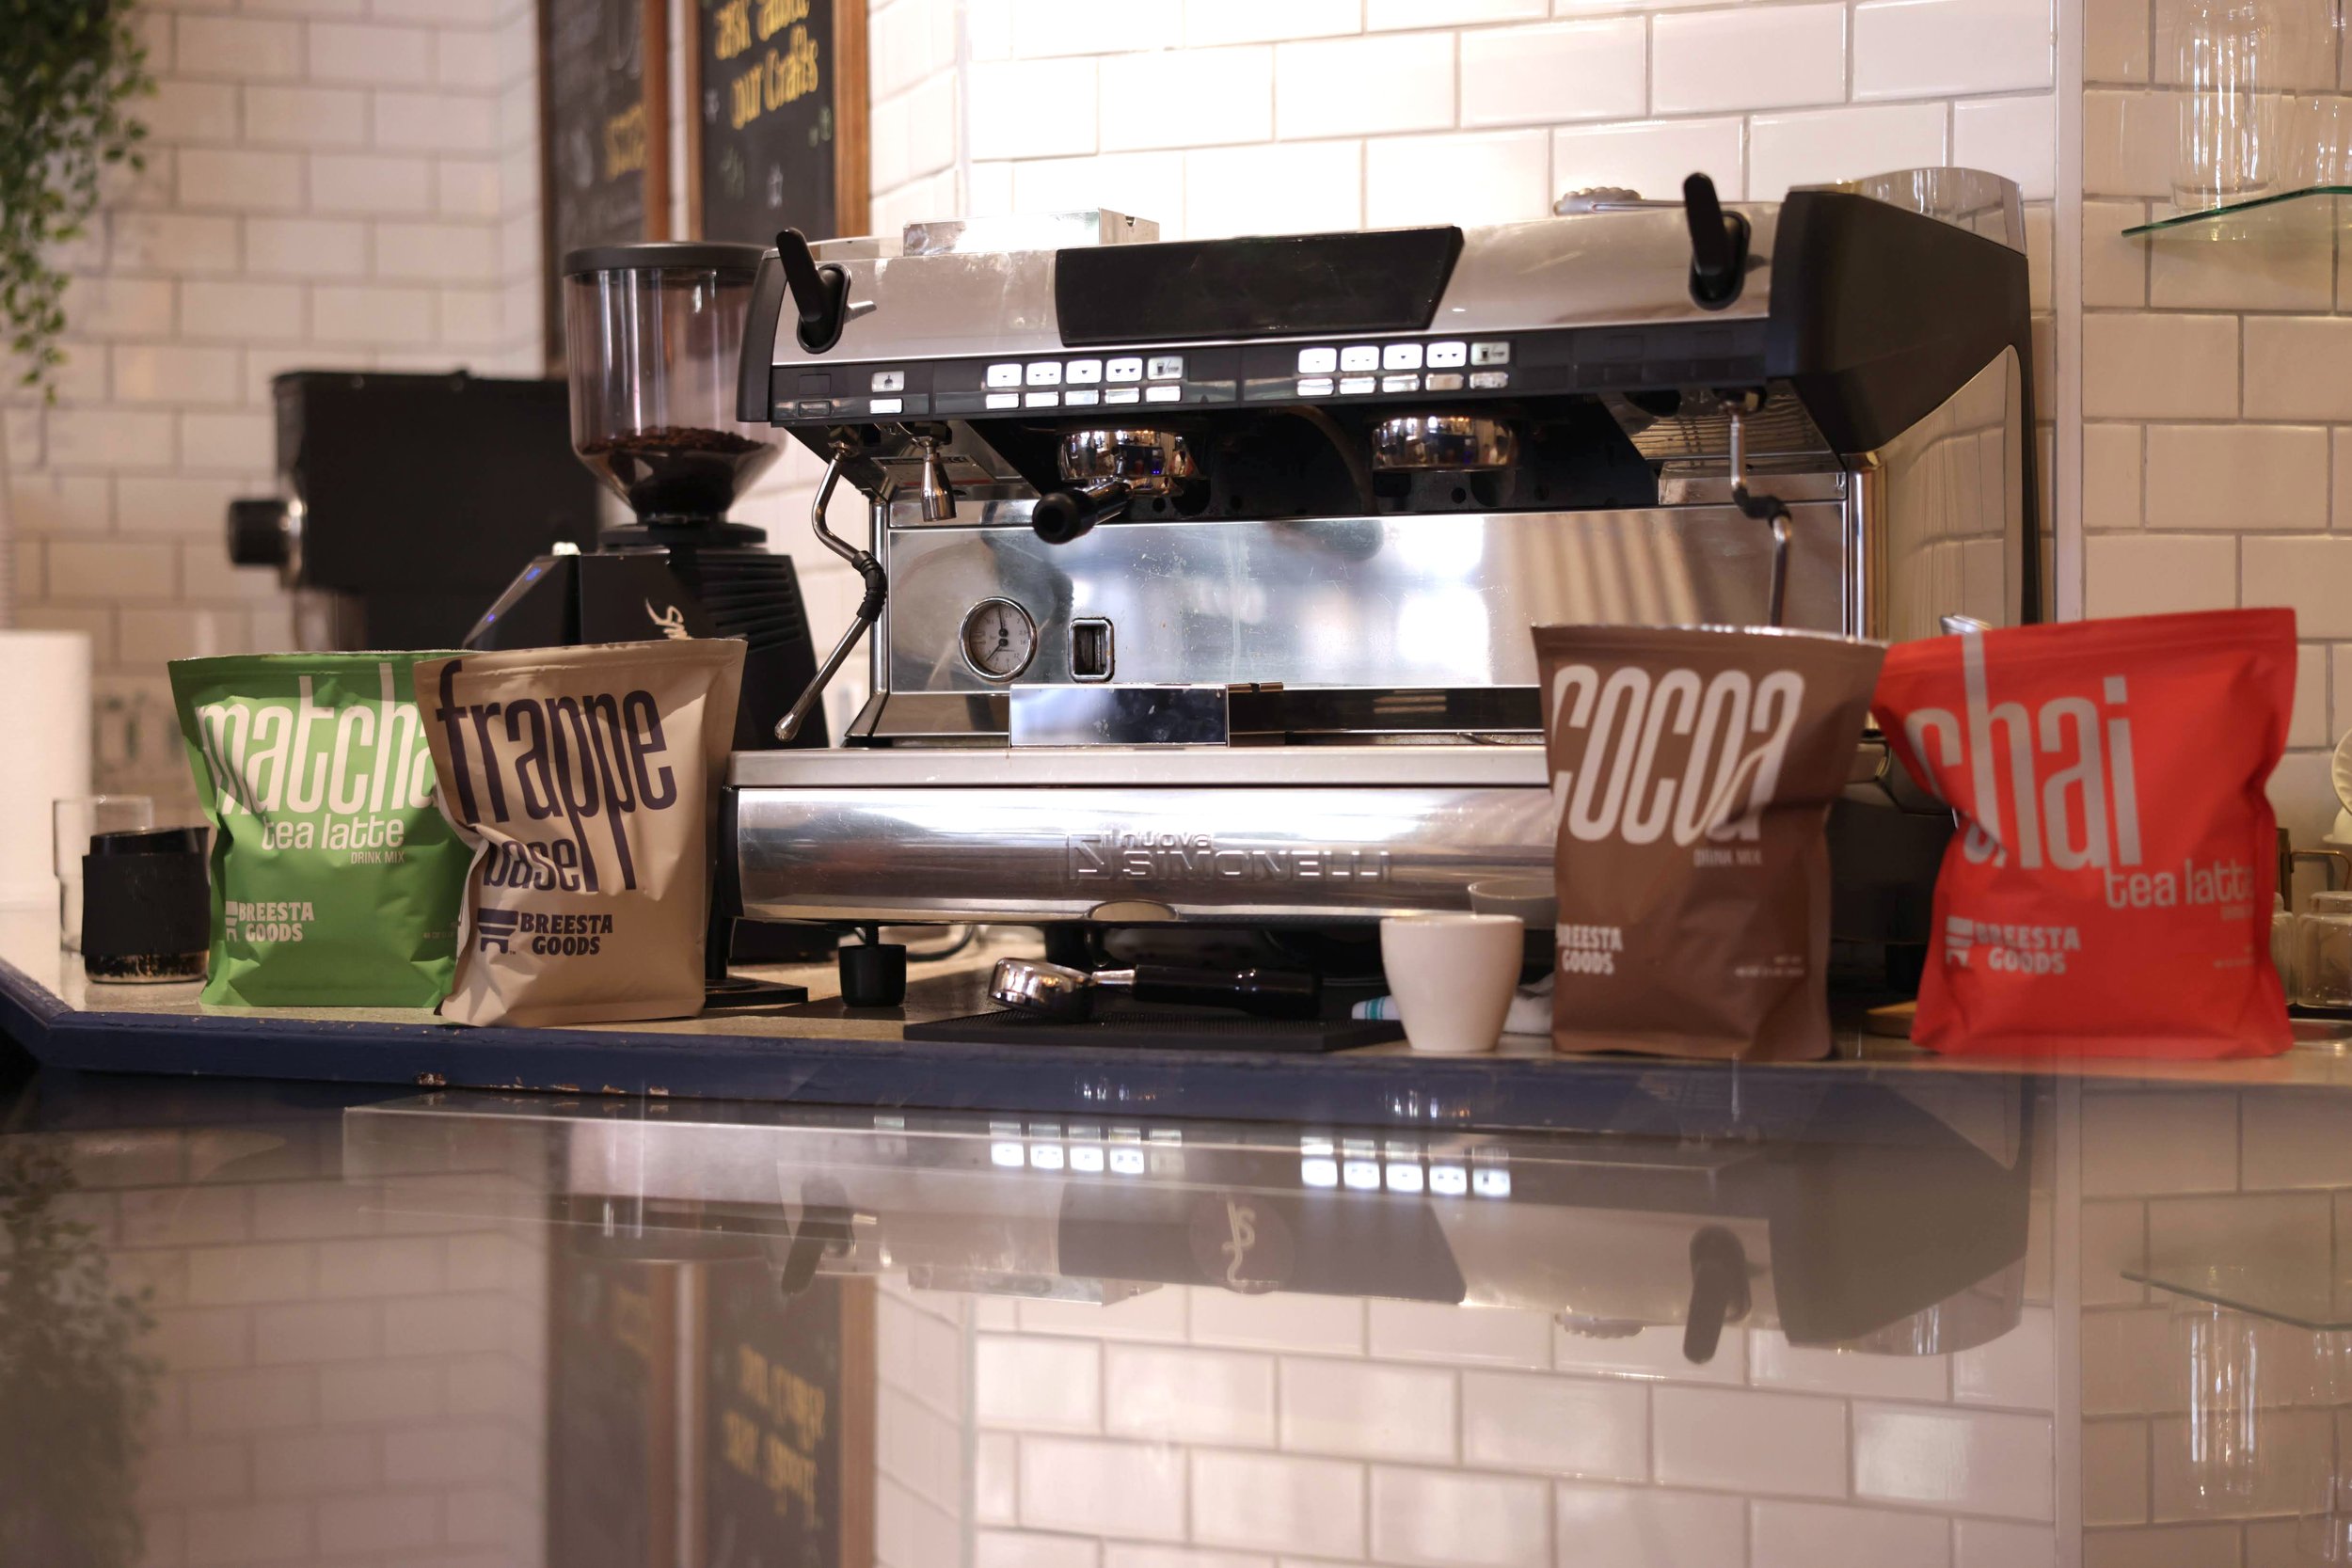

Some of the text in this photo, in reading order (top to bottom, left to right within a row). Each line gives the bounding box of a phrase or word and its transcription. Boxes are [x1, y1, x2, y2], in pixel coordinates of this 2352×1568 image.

[195, 662, 437, 815] matcha
[1904, 632, 2142, 870] chai
[1553, 664, 1805, 847] cocoa
[436, 659, 677, 893] frappe
[262, 814, 405, 850] tea latte
[1118, 831, 1211, 847] nuova
[351, 851, 405, 864] DRINK MIX
[1122, 849, 1391, 880] SIMONELLI
[2105, 865, 2177, 909] tea
[239, 902, 315, 922] BREESTA
[519, 912, 613, 935] BREESTA
[246, 923, 304, 942] GOODS
[532, 935, 601, 957] GOODS
[1562, 949, 1615, 975] GOODS
[1988, 947, 2067, 974] GOODS
